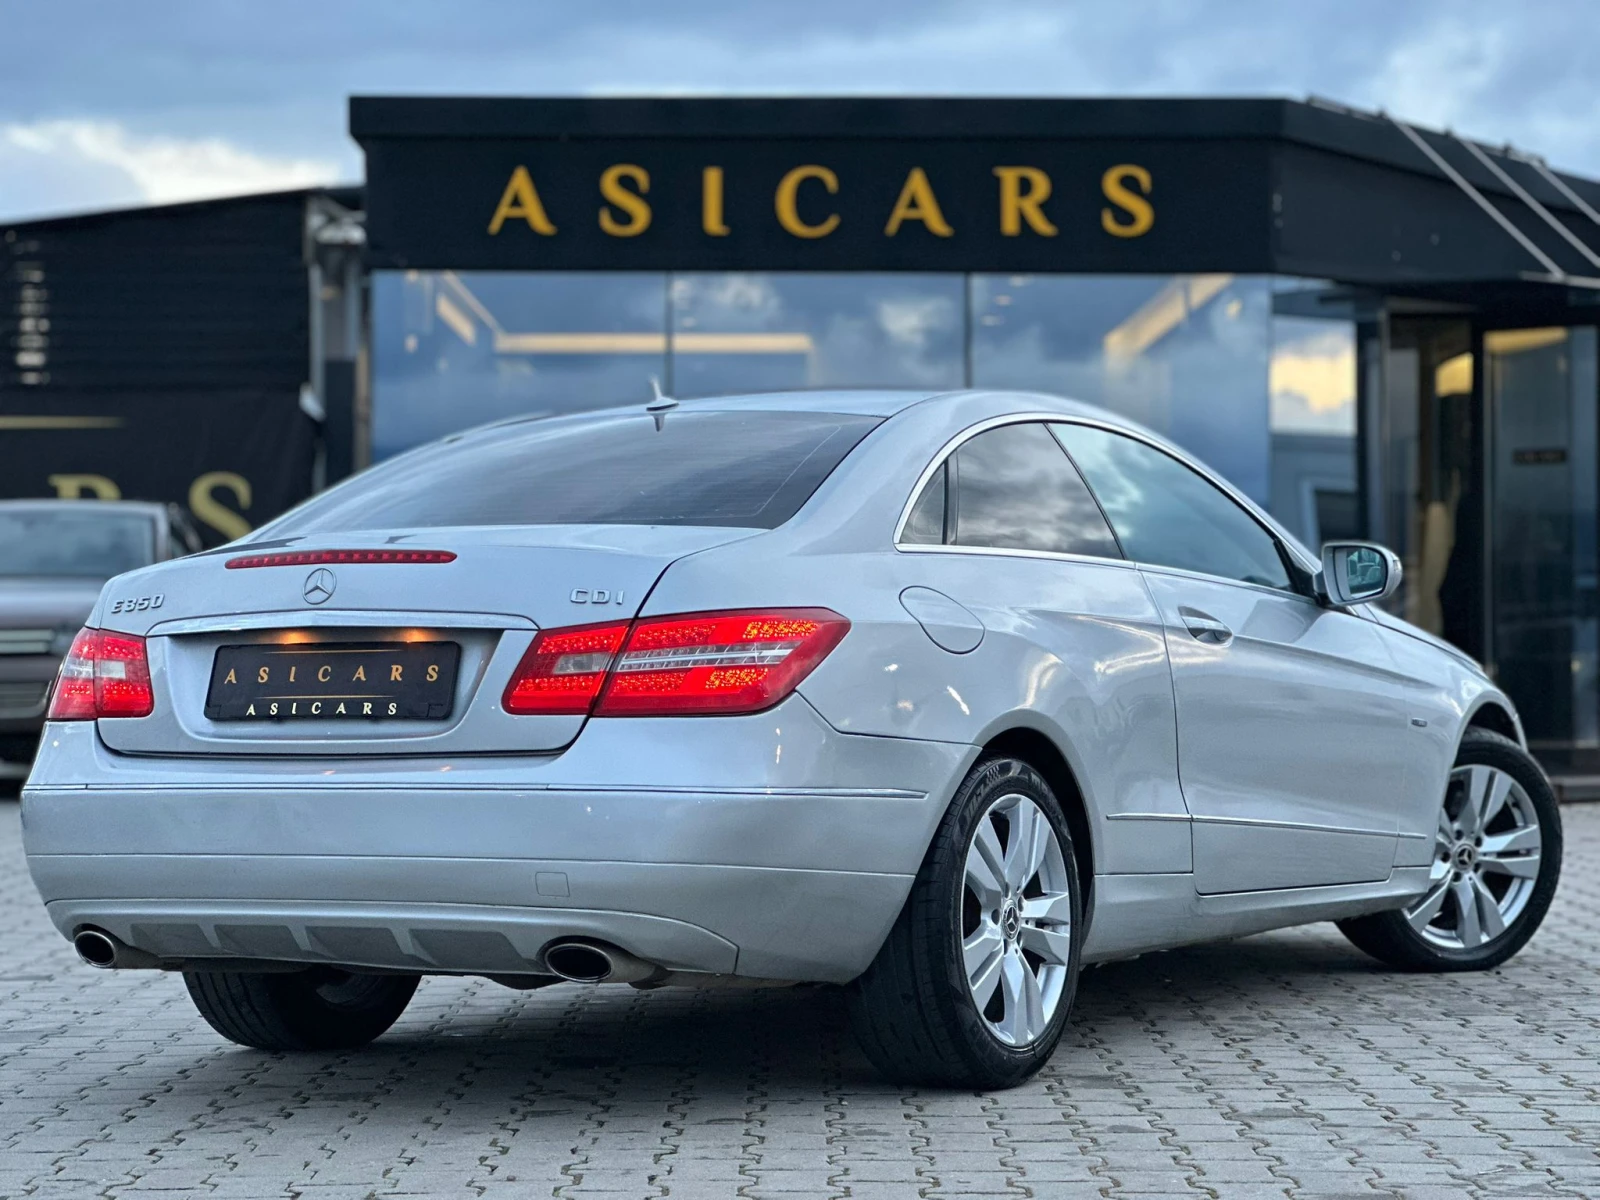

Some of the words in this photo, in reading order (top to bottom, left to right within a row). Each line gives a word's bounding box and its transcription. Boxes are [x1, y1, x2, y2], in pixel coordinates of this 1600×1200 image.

[488, 163, 1156, 238] ASICARS
[111, 594, 165, 614] E350
[570, 588, 625, 605] CDI
[224, 664, 439, 685] ASICARS
[246, 702, 397, 716] ASICARS
